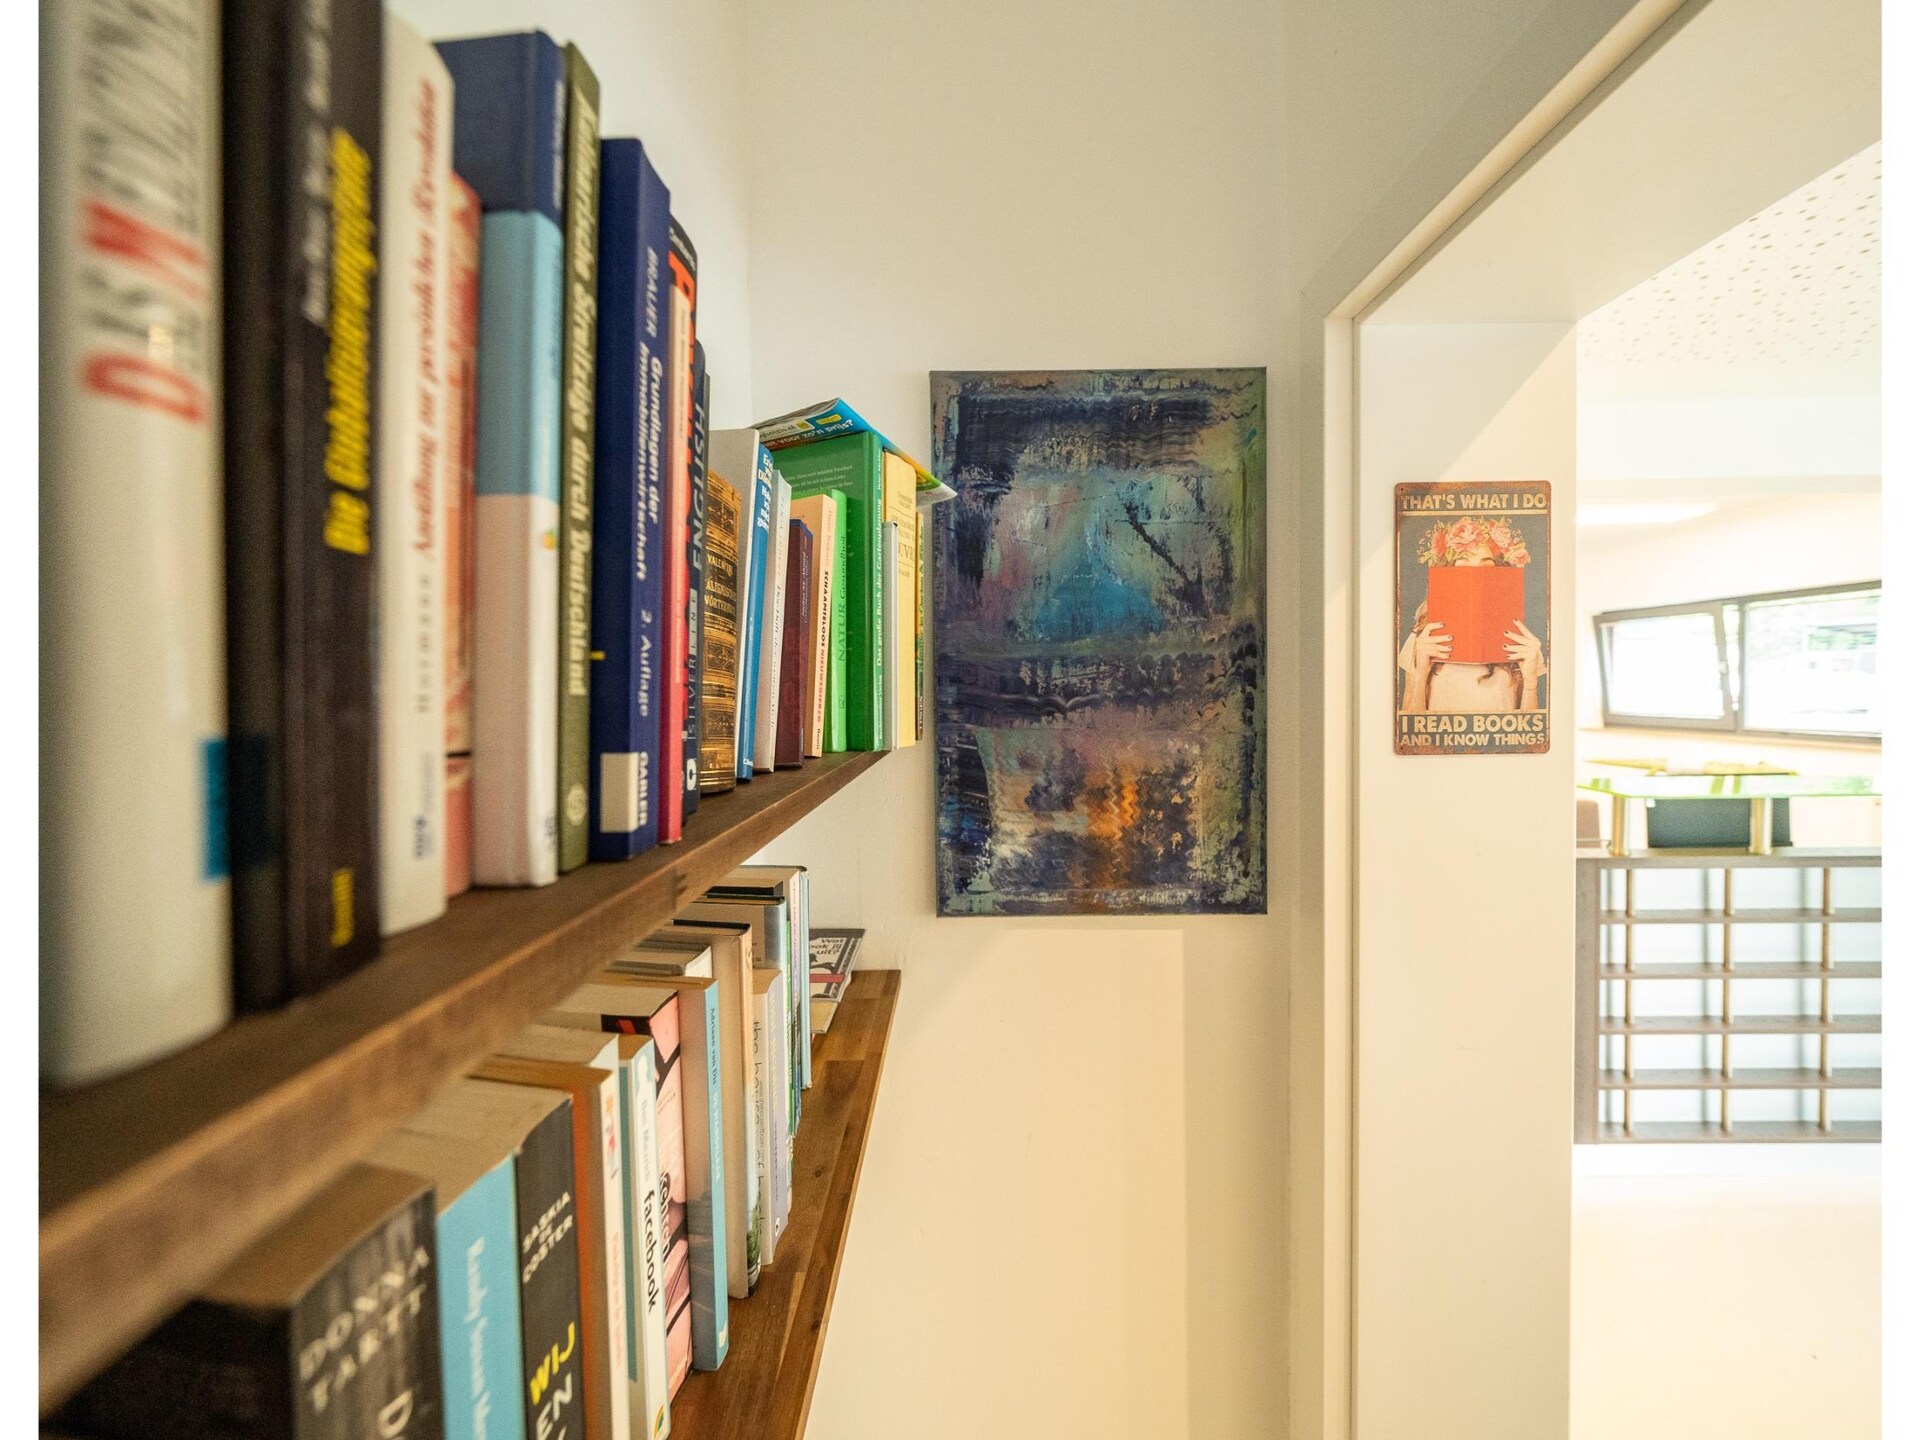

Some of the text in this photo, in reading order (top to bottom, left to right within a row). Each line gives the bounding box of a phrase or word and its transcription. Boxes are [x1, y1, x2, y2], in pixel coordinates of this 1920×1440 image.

[571, 437, 591, 522] durch
[648, 356, 664, 525] Grundlagen der
[693, 401, 707, 571] ENGLISH
[1400, 493, 1547, 510] THAT'S WHAT I DO
[569, 528, 592, 697] Deutschland
[837, 535, 846, 663] NATUR Gesundheit
[638, 634, 652, 718] Auflage
[1400, 733, 1545, 747] AND I KNOW THINGS
[1401, 714, 1545, 733] I READ BOOKS
[639, 751, 650, 827] GABLER
[710, 1007, 718, 1047] Adriaan
[522, 1191, 572, 1255] SASKIA
[522, 1215, 574, 1284] COSTER
[538, 1223, 553, 1245] DE
[644, 1189, 660, 1315] facebook
[298, 1246, 430, 1382] DONNA
[311, 1283, 428, 1417] TARTT
[529, 1320, 576, 1406] WIJ
[536, 1371, 573, 1440] EN
